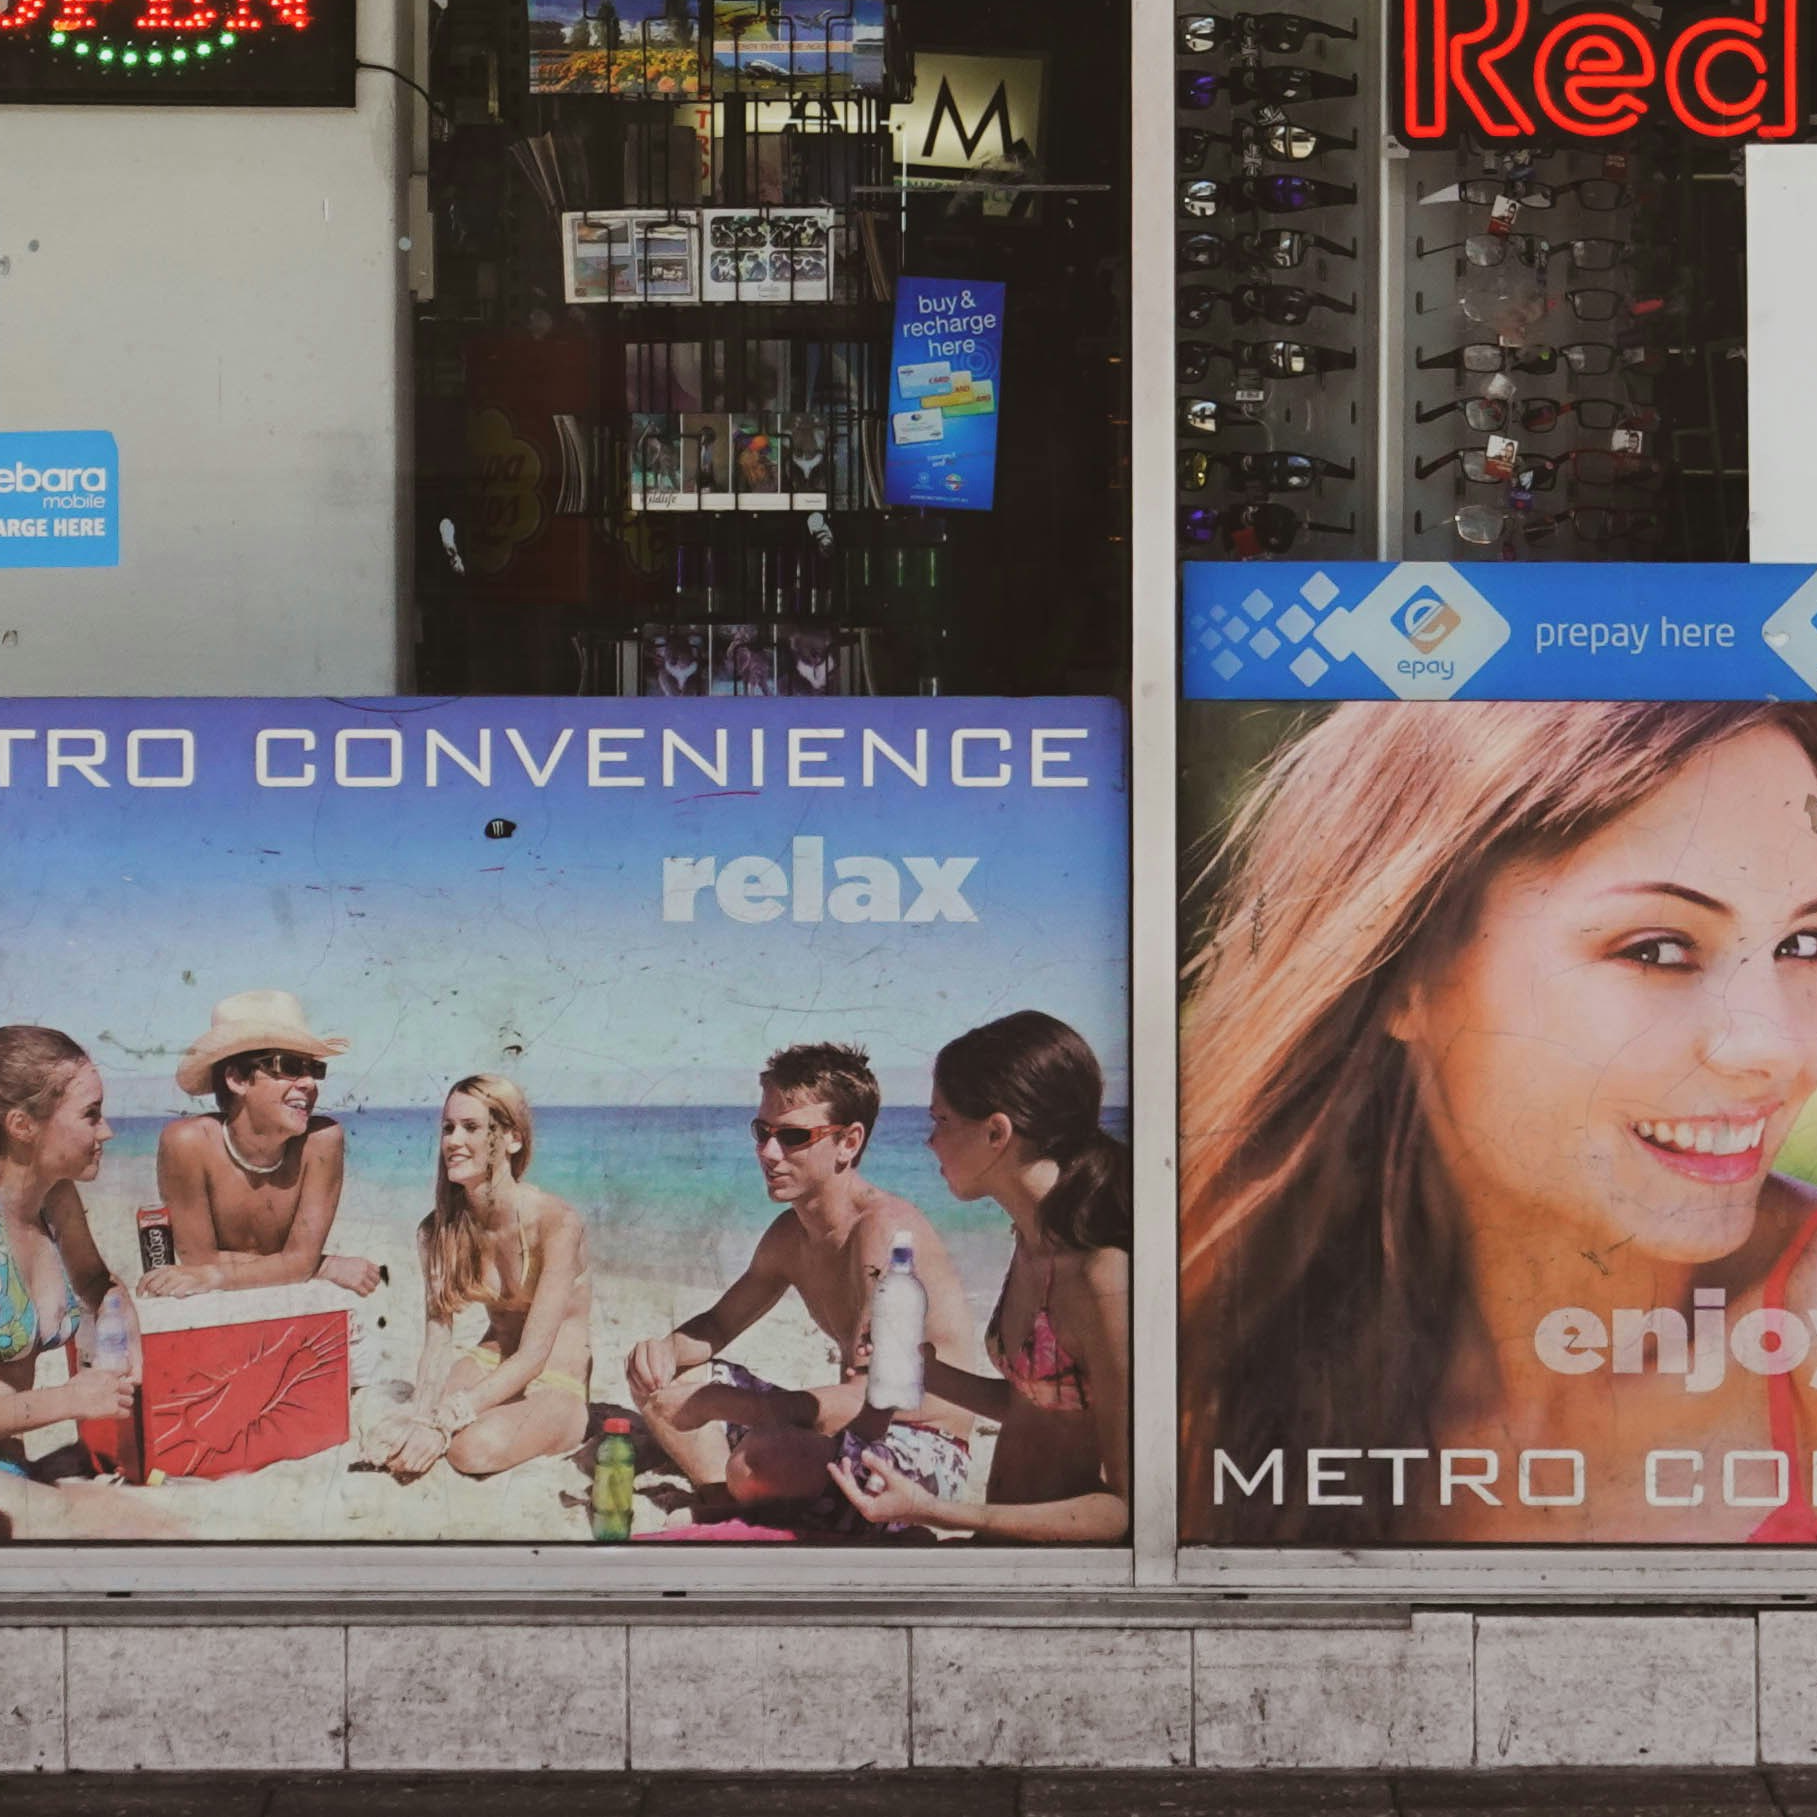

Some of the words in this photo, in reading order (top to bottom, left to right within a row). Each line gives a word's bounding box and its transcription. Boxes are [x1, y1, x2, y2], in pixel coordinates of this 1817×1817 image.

[917, 293, 957, 316] buy
[960, 289, 977, 310] &
[902, 312, 997, 338] recharge
[928, 338, 976, 359] here
[42, 494, 106, 510] mobile
[53, 517, 106, 538] HERE
[1536, 621, 1650, 655] prepay
[1661, 615, 1735, 647] here
[1396, 659, 1454, 680] epay
[255, 725, 1090, 789] CONVENIENCE
[661, 835, 981, 925] relax
[1211, 1446, 1586, 1508] METRO
